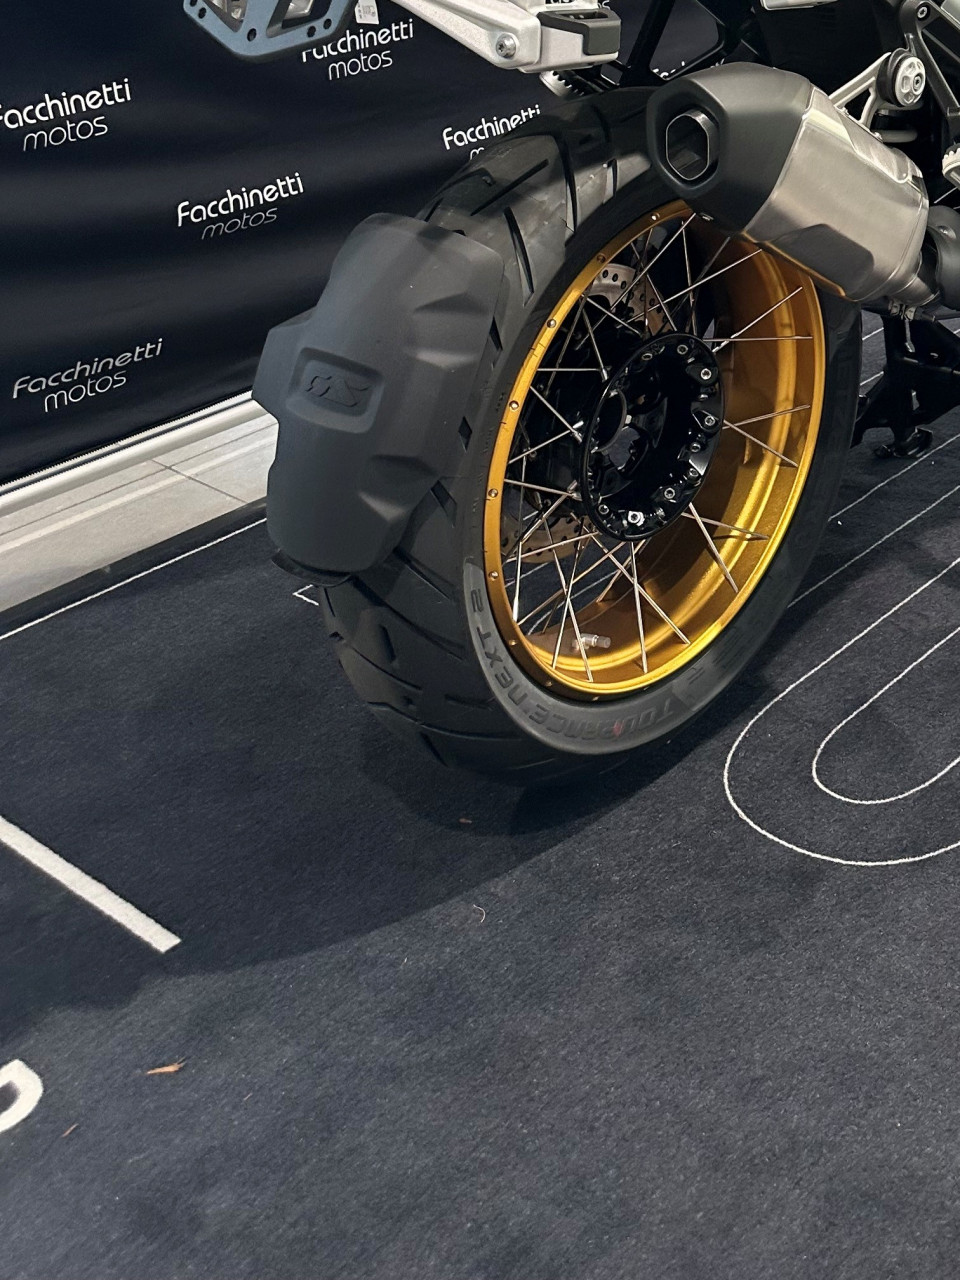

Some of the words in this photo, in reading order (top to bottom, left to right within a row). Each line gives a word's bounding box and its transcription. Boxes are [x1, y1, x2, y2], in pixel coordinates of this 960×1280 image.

[328, 50, 393, 81] motos
[23, 116, 108, 151] motos
[177, 172, 304, 226] Facchinetti
[201, 206, 277, 239] motos
[12, 338, 162, 399] Facchinetti
[44, 371, 127, 412] motos
